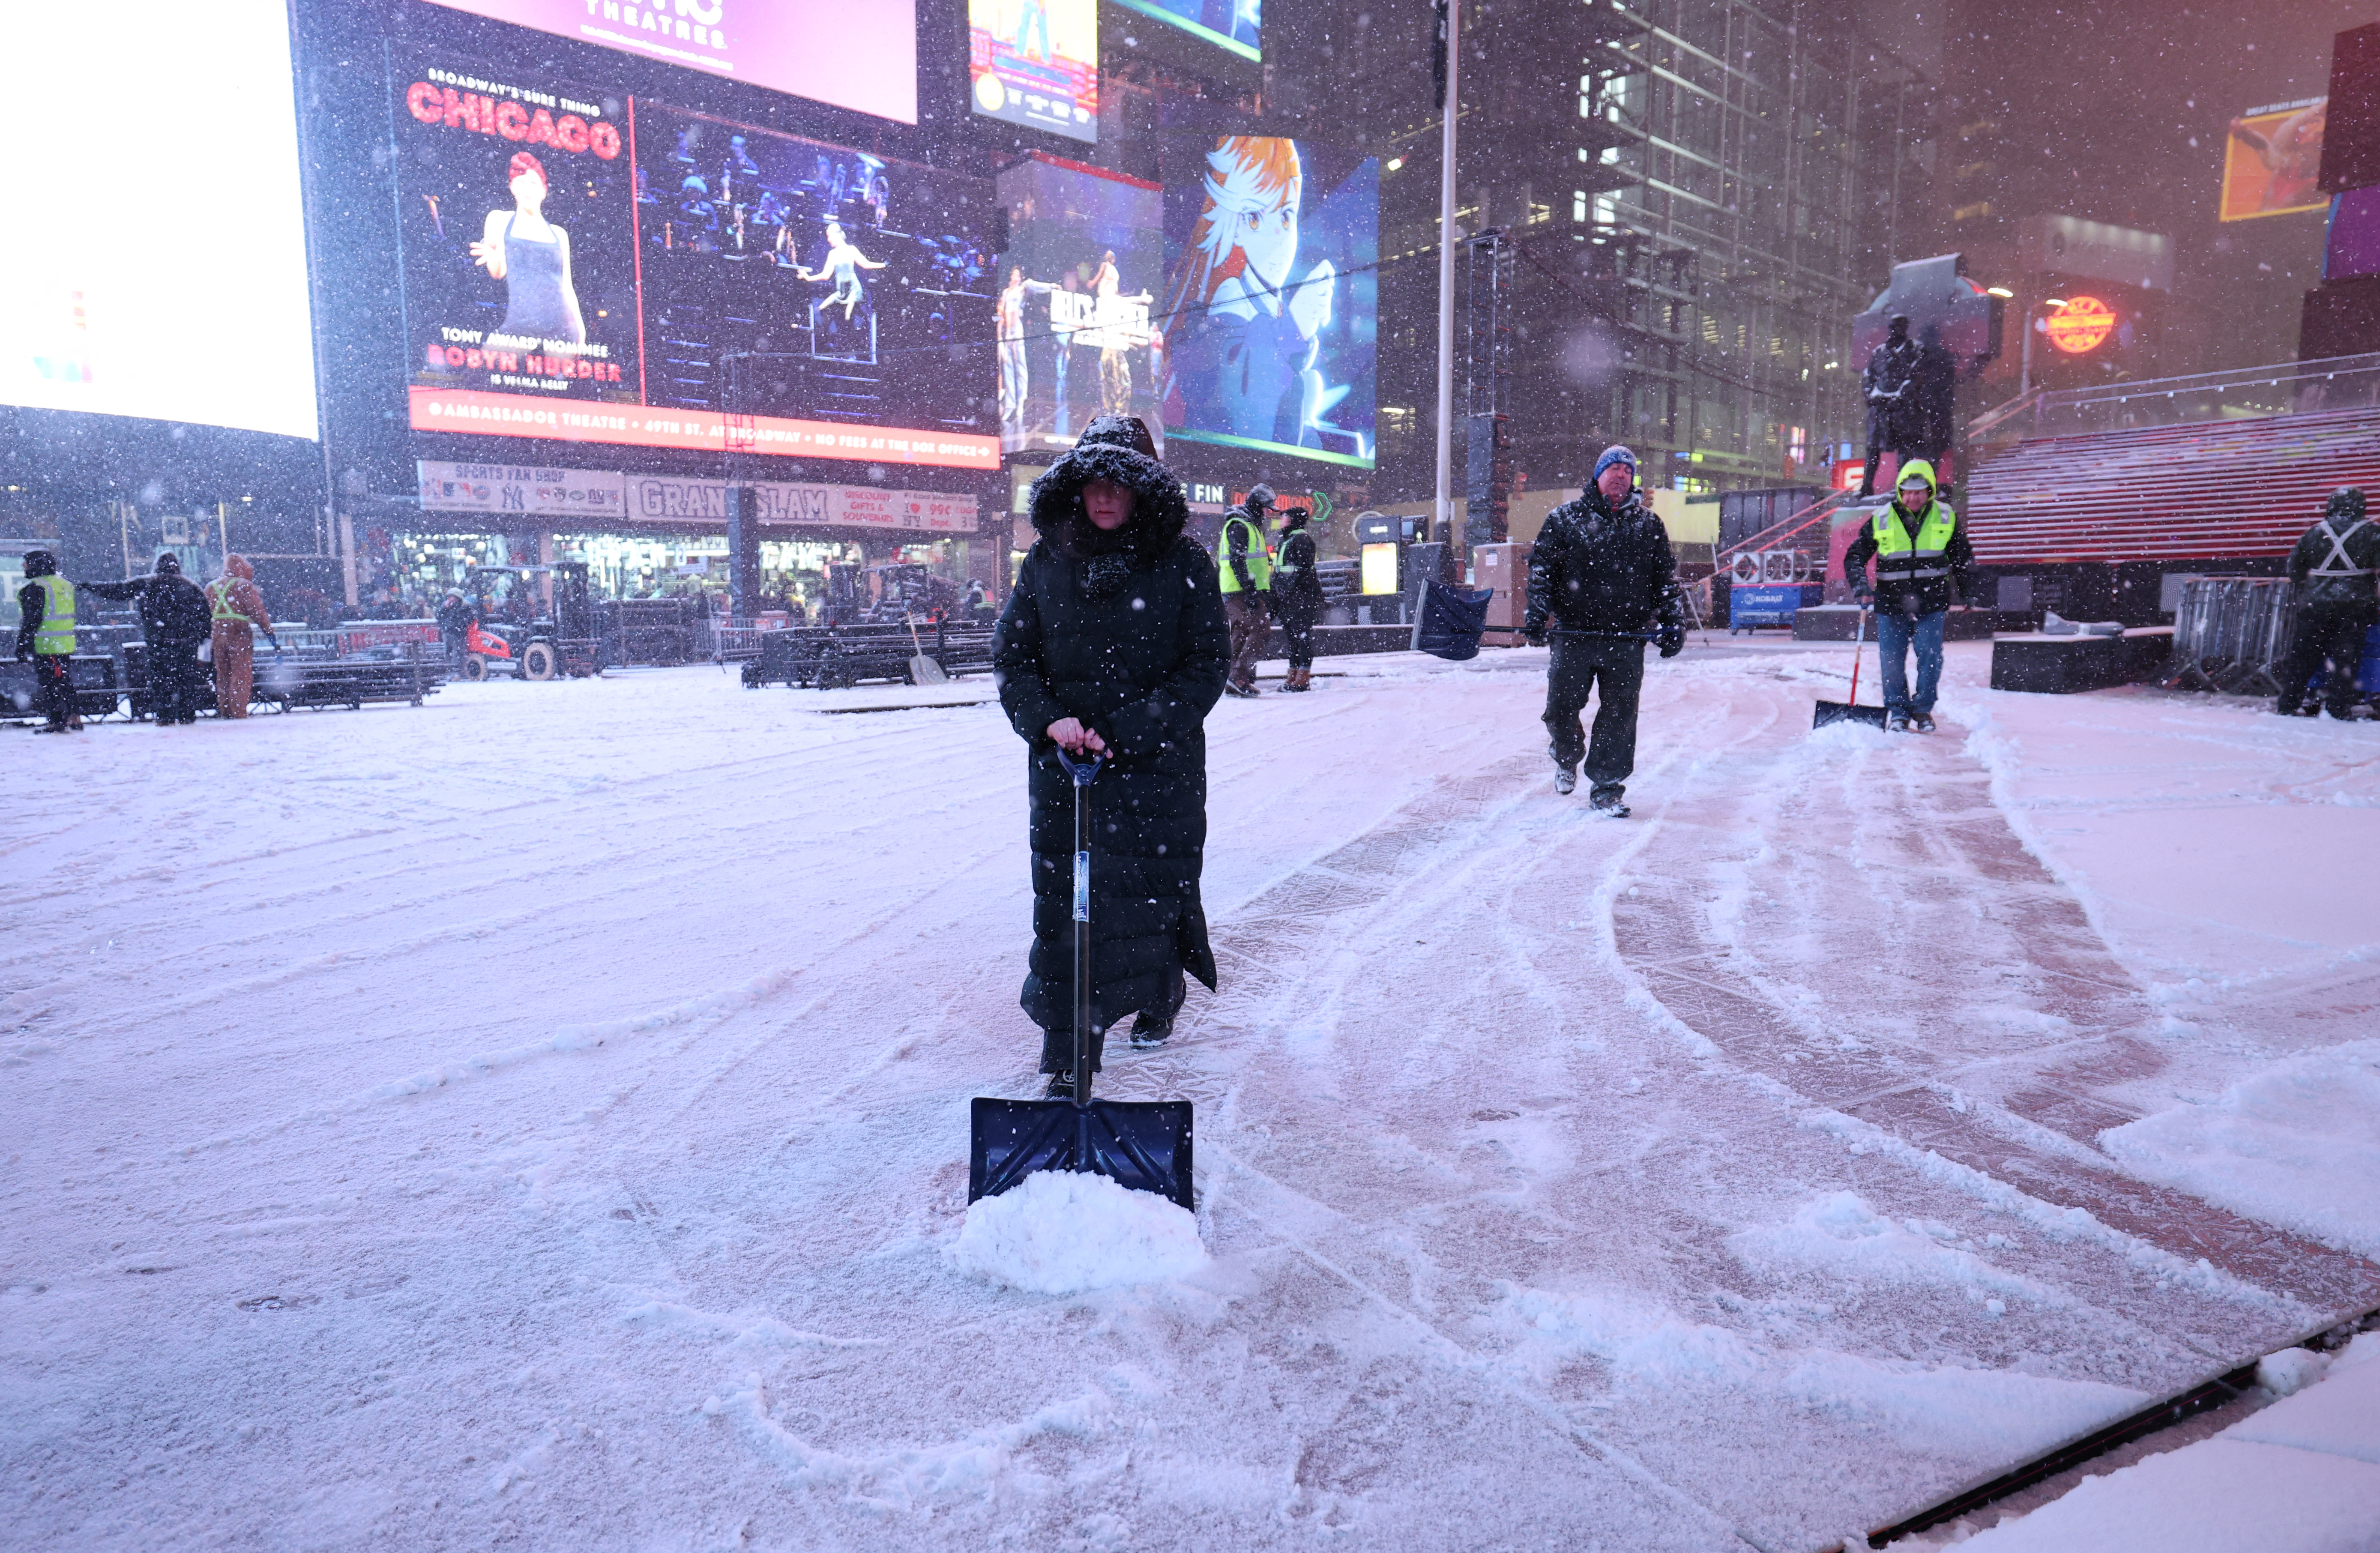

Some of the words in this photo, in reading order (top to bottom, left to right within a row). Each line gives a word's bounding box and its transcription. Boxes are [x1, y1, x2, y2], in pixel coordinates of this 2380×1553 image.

[585, 0, 726, 49] THEATRES
[428, 68, 519, 99] BROADWAY'S
[524, 90, 556, 108] SURE
[560, 98, 600, 117] THING
[407, 82, 621, 160] CHICAGO
[441, 327, 483, 344] TONY
[543, 338, 609, 358] NOMINEE
[428, 344, 518, 372] ROBYN
[526, 354, 622, 382] HURDER
[491, 374, 502, 385] IS
[503, 375, 539, 389] VELMA
[443, 404, 557, 425] AMBASSADOR
[562, 413, 626, 430] THEATRE
[644, 420, 680, 434] 49TH
[685, 423, 704, 436] ST.
[709, 425, 725, 437] AT
[729, 427, 801, 443] BROADWAY
[815, 434, 835, 446] NO
[839, 435, 867, 449] FEES
[870, 438, 885, 449] AT
[888, 440, 909, 451] THE
[912, 442, 935, 454] BOX
[938, 444, 977, 457] OFFICE
[455, 465, 503, 480] SPORTS
[507, 467, 531, 481] FAN
[536, 469, 565, 482] SHOP
[755, 484, 828, 521] SLAM
[845, 491, 891, 501] DISCOUNT
[850, 501, 875, 511] GIFTS
[843, 512, 894, 522] SOUVENIRS
[902, 514, 921, 527] NY
